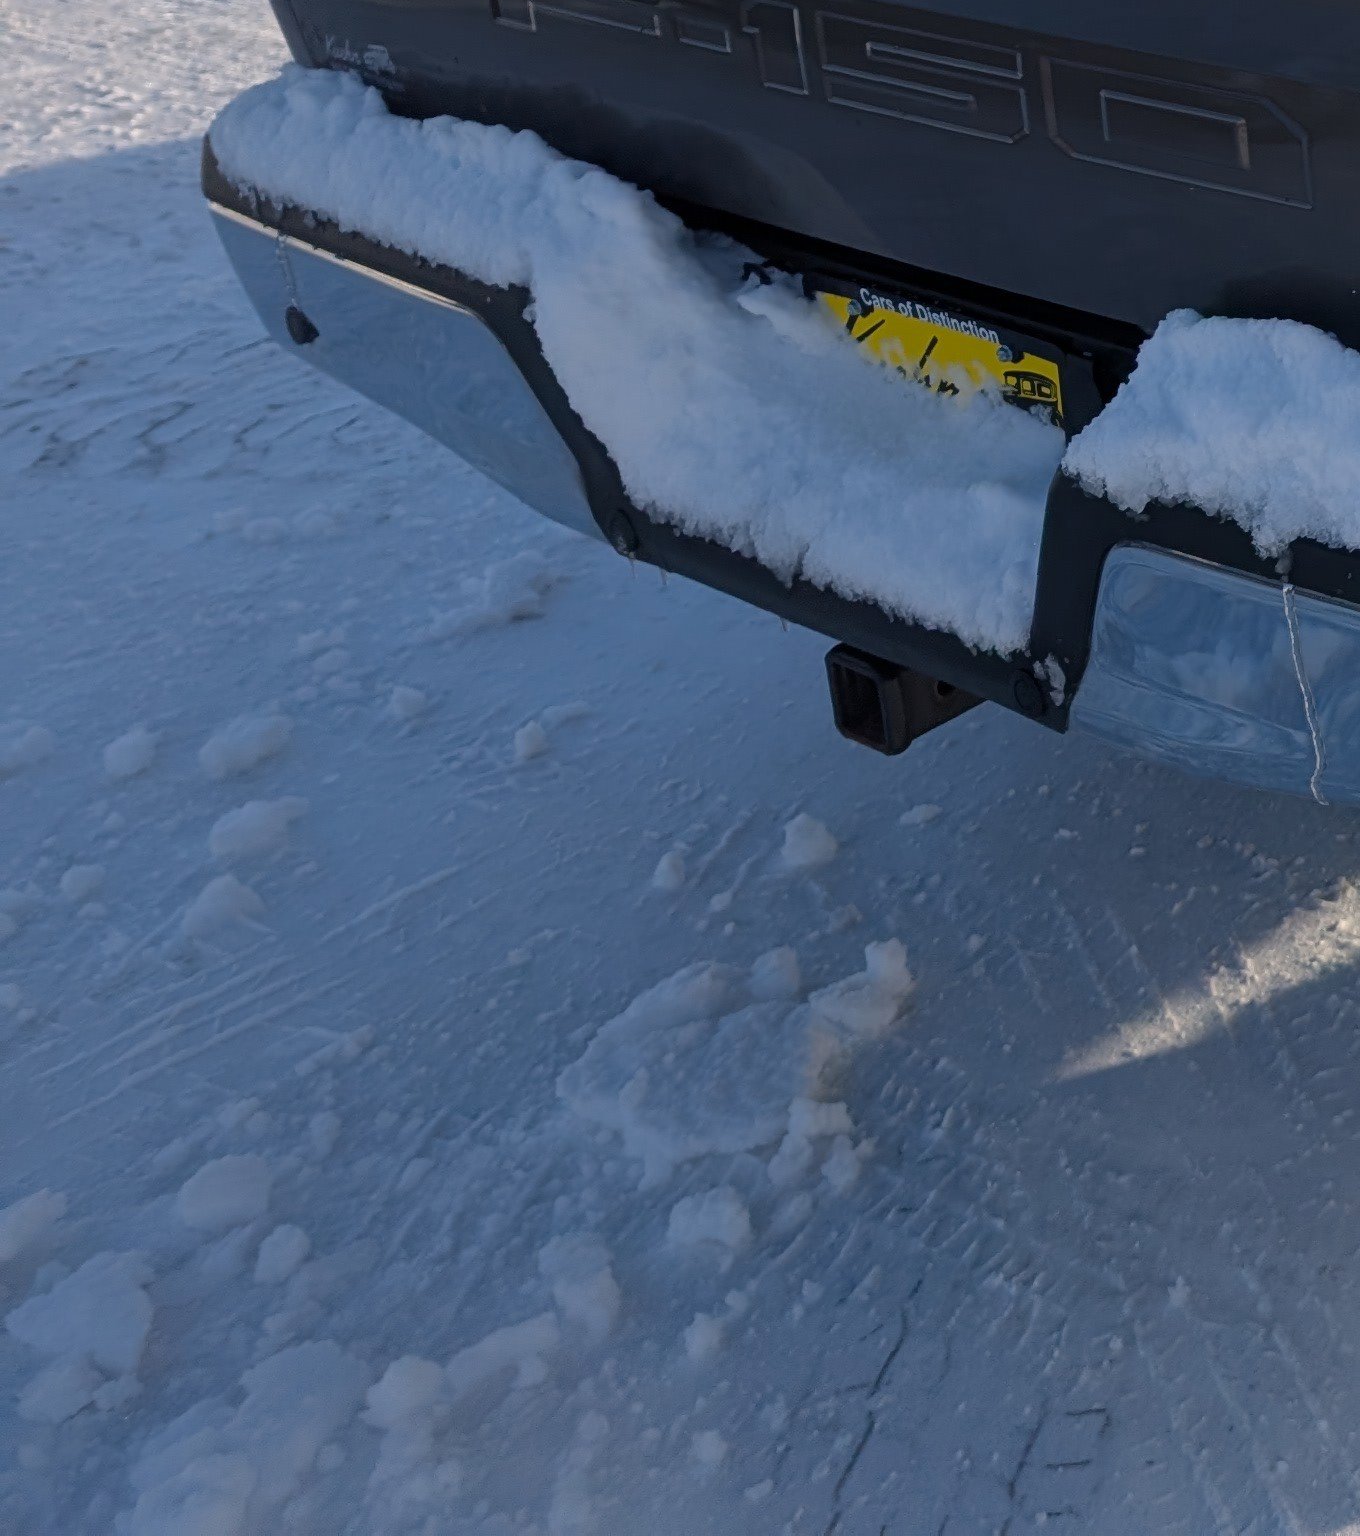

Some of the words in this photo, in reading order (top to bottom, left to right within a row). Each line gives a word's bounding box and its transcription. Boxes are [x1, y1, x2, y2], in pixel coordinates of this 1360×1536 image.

[860, 287, 896, 312] Cars
[898, 300, 913, 318] of
[915, 303, 1000, 344] Distinction
